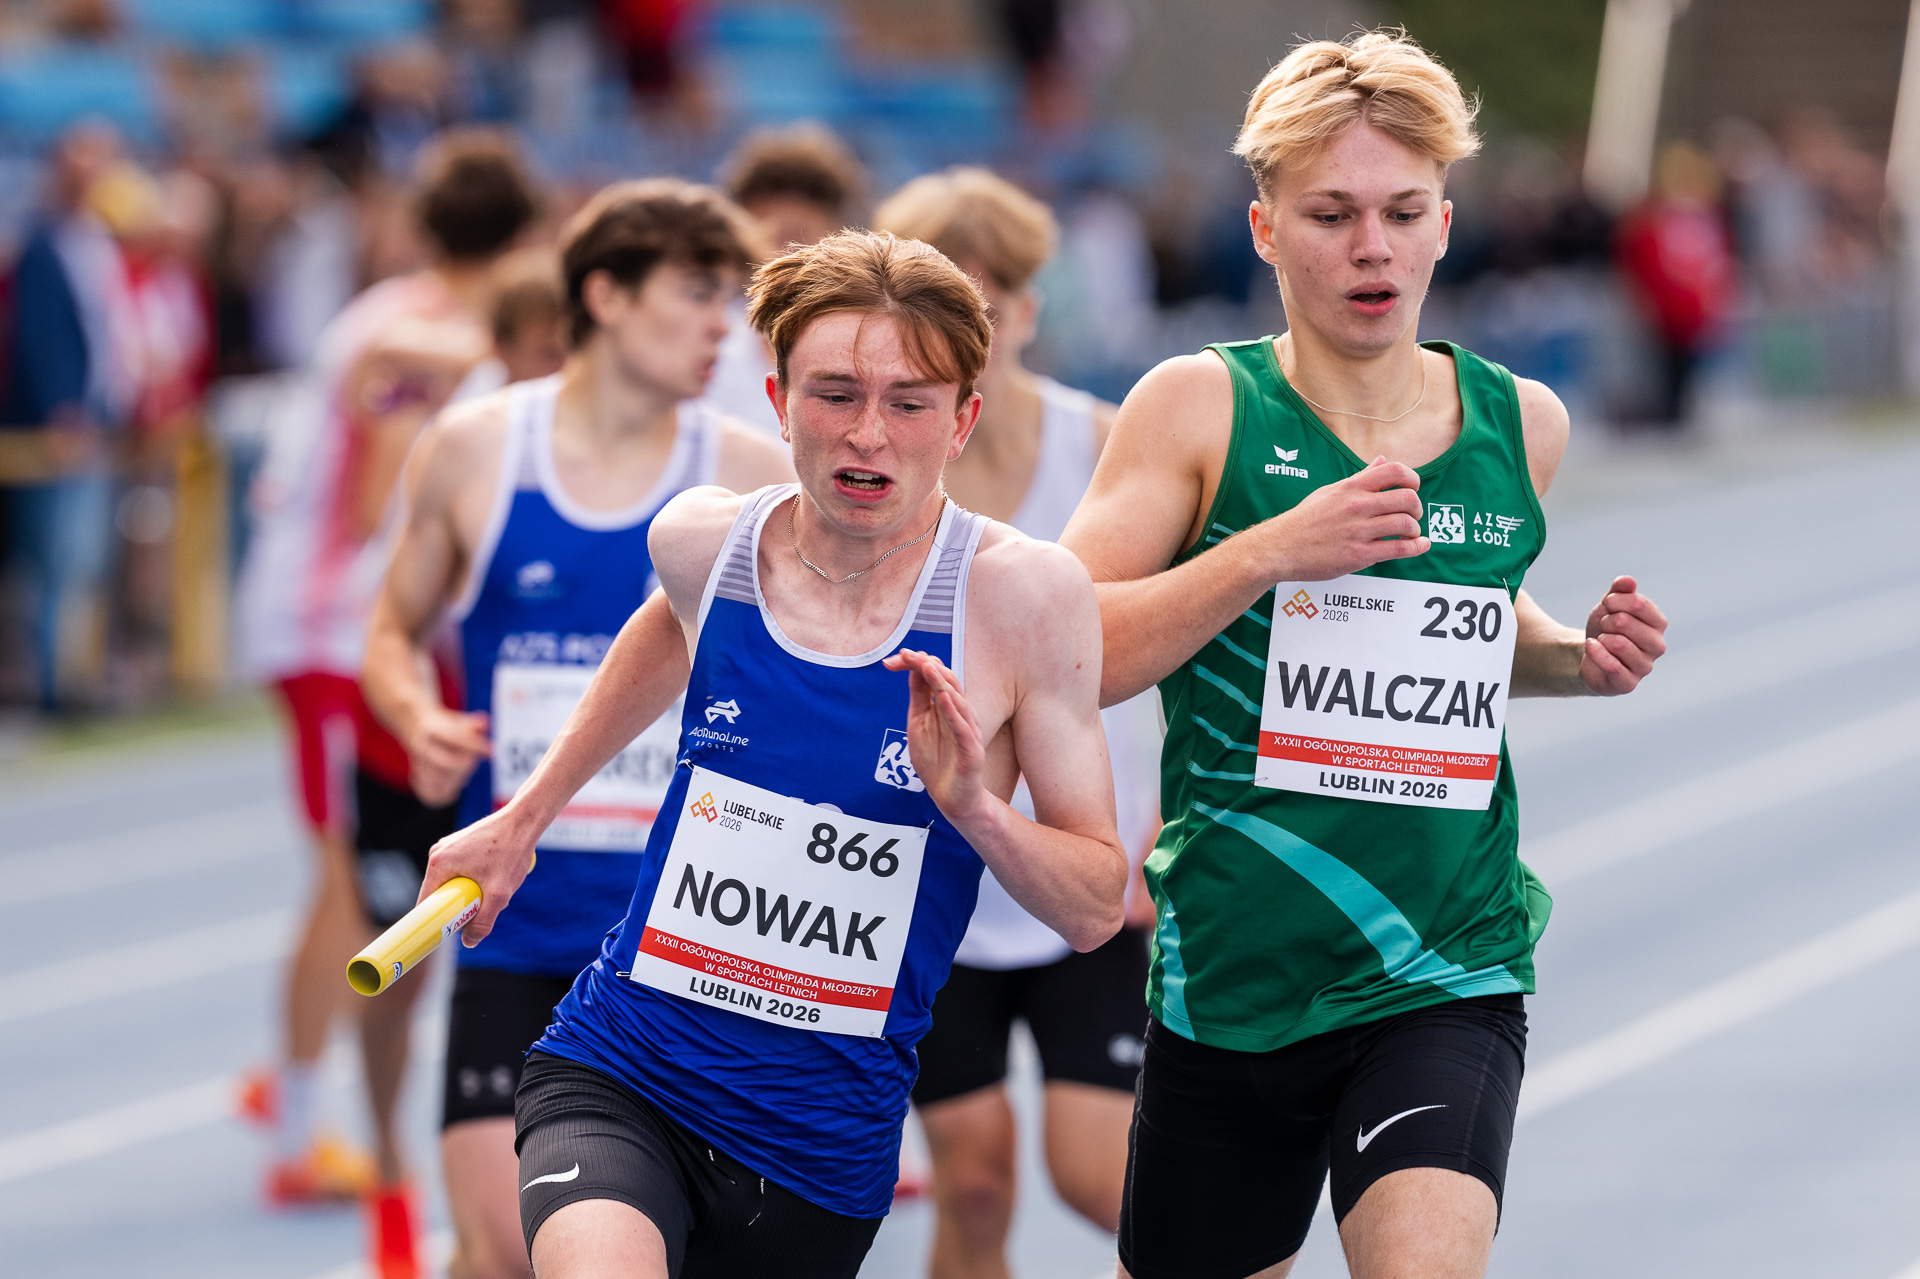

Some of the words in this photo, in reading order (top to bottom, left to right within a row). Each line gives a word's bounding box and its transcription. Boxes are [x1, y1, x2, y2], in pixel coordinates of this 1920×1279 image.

[1264, 462, 1309, 479] erima
[1322, 608, 1349, 623] 2026
[1323, 593, 1395, 613] LUBELSKIE
[1420, 596, 1502, 643] 230
[1277, 660, 1500, 729] WALCZAK
[695, 740, 734, 753] SPORTS
[1273, 735, 1302, 748] XXXII
[1303, 739, 1390, 759] OGÓLNOPOLSKA
[1391, 750, 1445, 764] OLIMPIADA
[1446, 755, 1490, 768] MŁODZIEŻY
[1332, 755, 1344, 765] W
[1345, 756, 1403, 772] SPORTACH
[1404, 763, 1444, 775] LETNICH
[1319, 771, 1395, 795] LUBLIN
[1399, 780, 1448, 800] 2026
[719, 815, 742, 832] 2026
[723, 799, 785, 831] LUBELSKIE
[806, 822, 901, 878] 866
[672, 863, 887, 961] NOWAK
[654, 933, 679, 949] XXXII
[680, 940, 761, 974] OGÓLNOPOLSKA
[763, 966, 819, 989] OLIMPIADA
[821, 978, 879, 998] MŁODZIEŻY
[704, 961, 716, 972] W
[716, 964, 773, 991] SPORTACH
[774, 979, 818, 1000] LETNICH
[689, 976, 763, 1011] LUBLIN
[766, 998, 822, 1024] 2026
